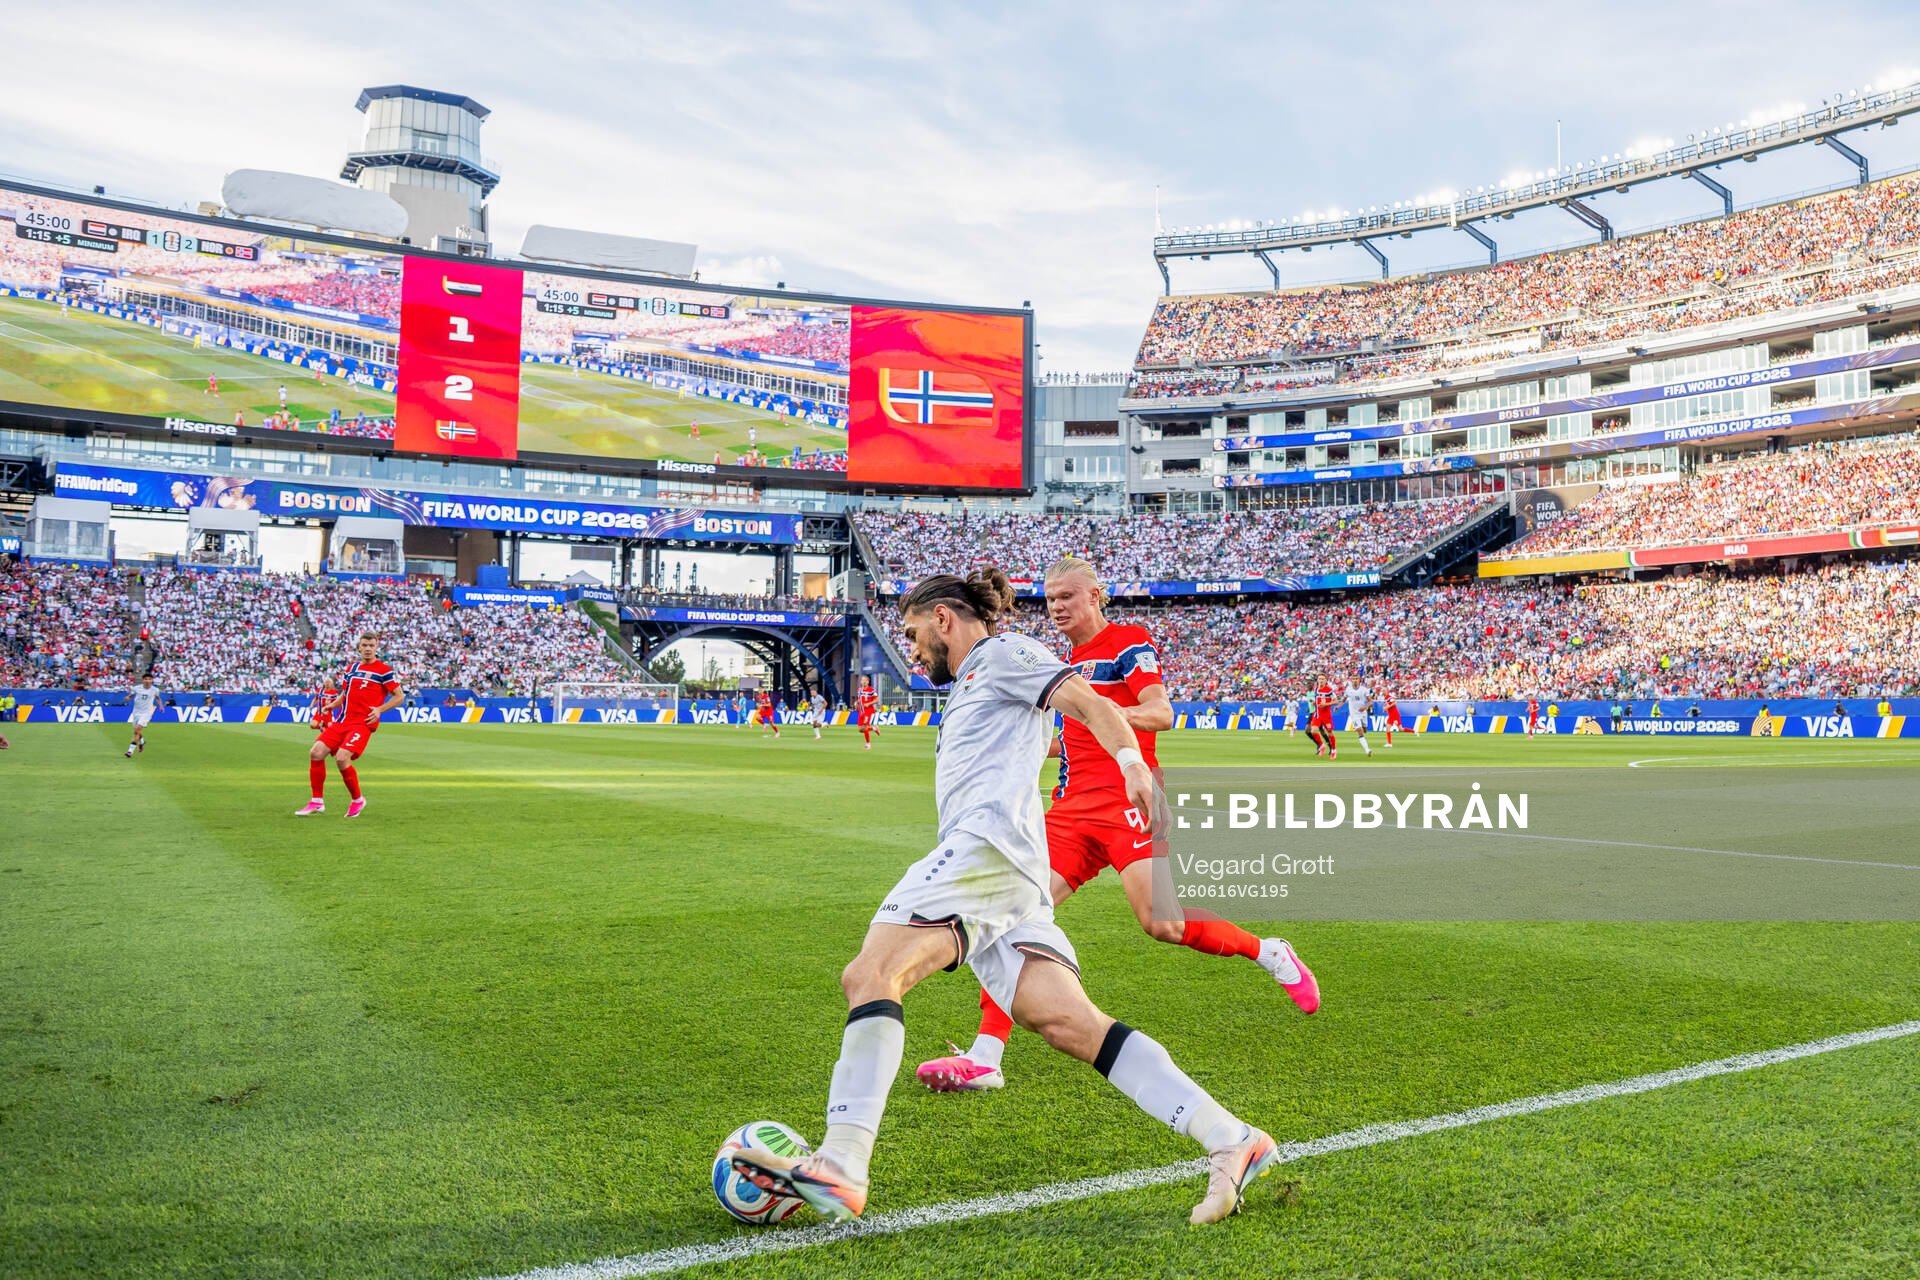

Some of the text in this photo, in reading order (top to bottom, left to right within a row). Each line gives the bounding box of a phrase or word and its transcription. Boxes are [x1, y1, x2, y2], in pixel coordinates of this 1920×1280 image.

[26, 213, 70, 230] 45:00
[26, 229, 114, 251] 1:15 +5 MINIMUM
[152, 234, 158, 244] 1
[184, 240, 192, 250] 2
[201, 241, 224, 254] NOR
[544, 290, 579, 302] 45:00
[544, 303, 564, 313] 1:15
[566, 306, 580, 315] +5
[449, 316, 474, 342] 1
[444, 374, 474, 400] 2
[1664, 368, 1792, 396] FIFA WORLD CUP 2026
[1499, 406, 1540, 420] BOSTON
[164, 416, 238, 436] Hisense
[1664, 414, 1792, 441] FIFA WORLD CUP 2026
[1499, 448, 1540, 462] BOSTON
[657, 460, 716, 474] Hisense
[280, 490, 371, 512] BOSTON
[1536, 502, 1556, 511] FIFA
[423, 501, 648, 530] FIFA WORLD CUP 2026
[694, 518, 772, 536] BOSTON
[1724, 544, 1748, 556] IRAQ
[1196, 582, 1241, 592] BOSTON
[1346, 575, 1369, 585] FIFA
[583, 590, 614, 600] BOSTON
[688, 611, 786, 622] FIFA WORLD CUP 2026
[51, 706, 105, 722] VISA
[172, 706, 224, 722] VISA
[396, 707, 442, 723] VISA
[499, 708, 542, 723] VISA
[596, 708, 638, 723] VISA
[690, 710, 728, 724] VISA
[1262, 708, 1280, 716] FIFA
[1194, 716, 1218, 730] VISA
[1248, 716, 1272, 730] VISA
[1441, 716, 1474, 732] VISA
[1519, 716, 1558, 734] VSA
[1634, 720, 1672, 732] WORLD
[1673, 720, 1696, 732] CUP
[1696, 720, 1736, 732] 2026
[1801, 716, 1854, 737] VISA
